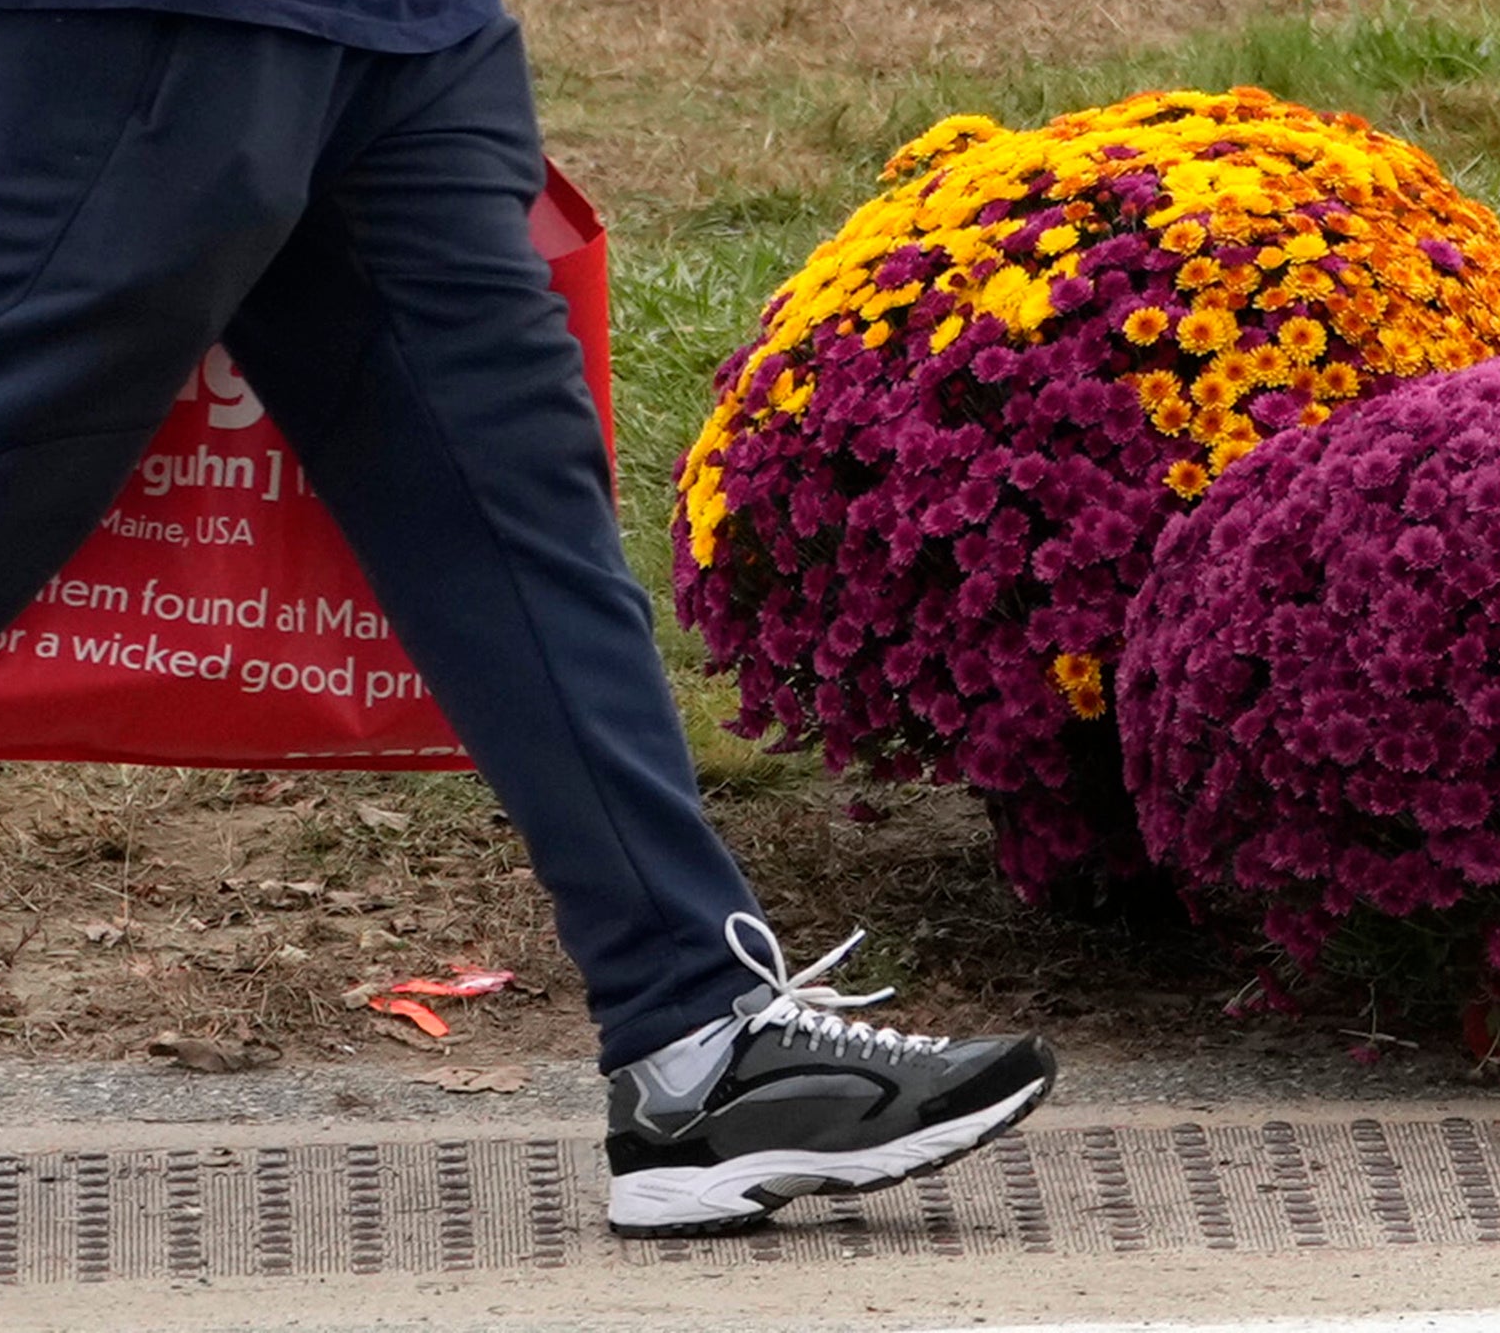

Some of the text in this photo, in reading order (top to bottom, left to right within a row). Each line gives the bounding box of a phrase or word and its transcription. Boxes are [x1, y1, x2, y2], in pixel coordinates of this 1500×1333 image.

[196, 516, 254, 546] USA
[140, 578, 268, 629] found
[276, 599, 306, 633] at
[35, 632, 60, 658] a
[73, 633, 233, 680] wicked
[241, 656, 354, 694] good
[366, 669, 432, 708] pri
